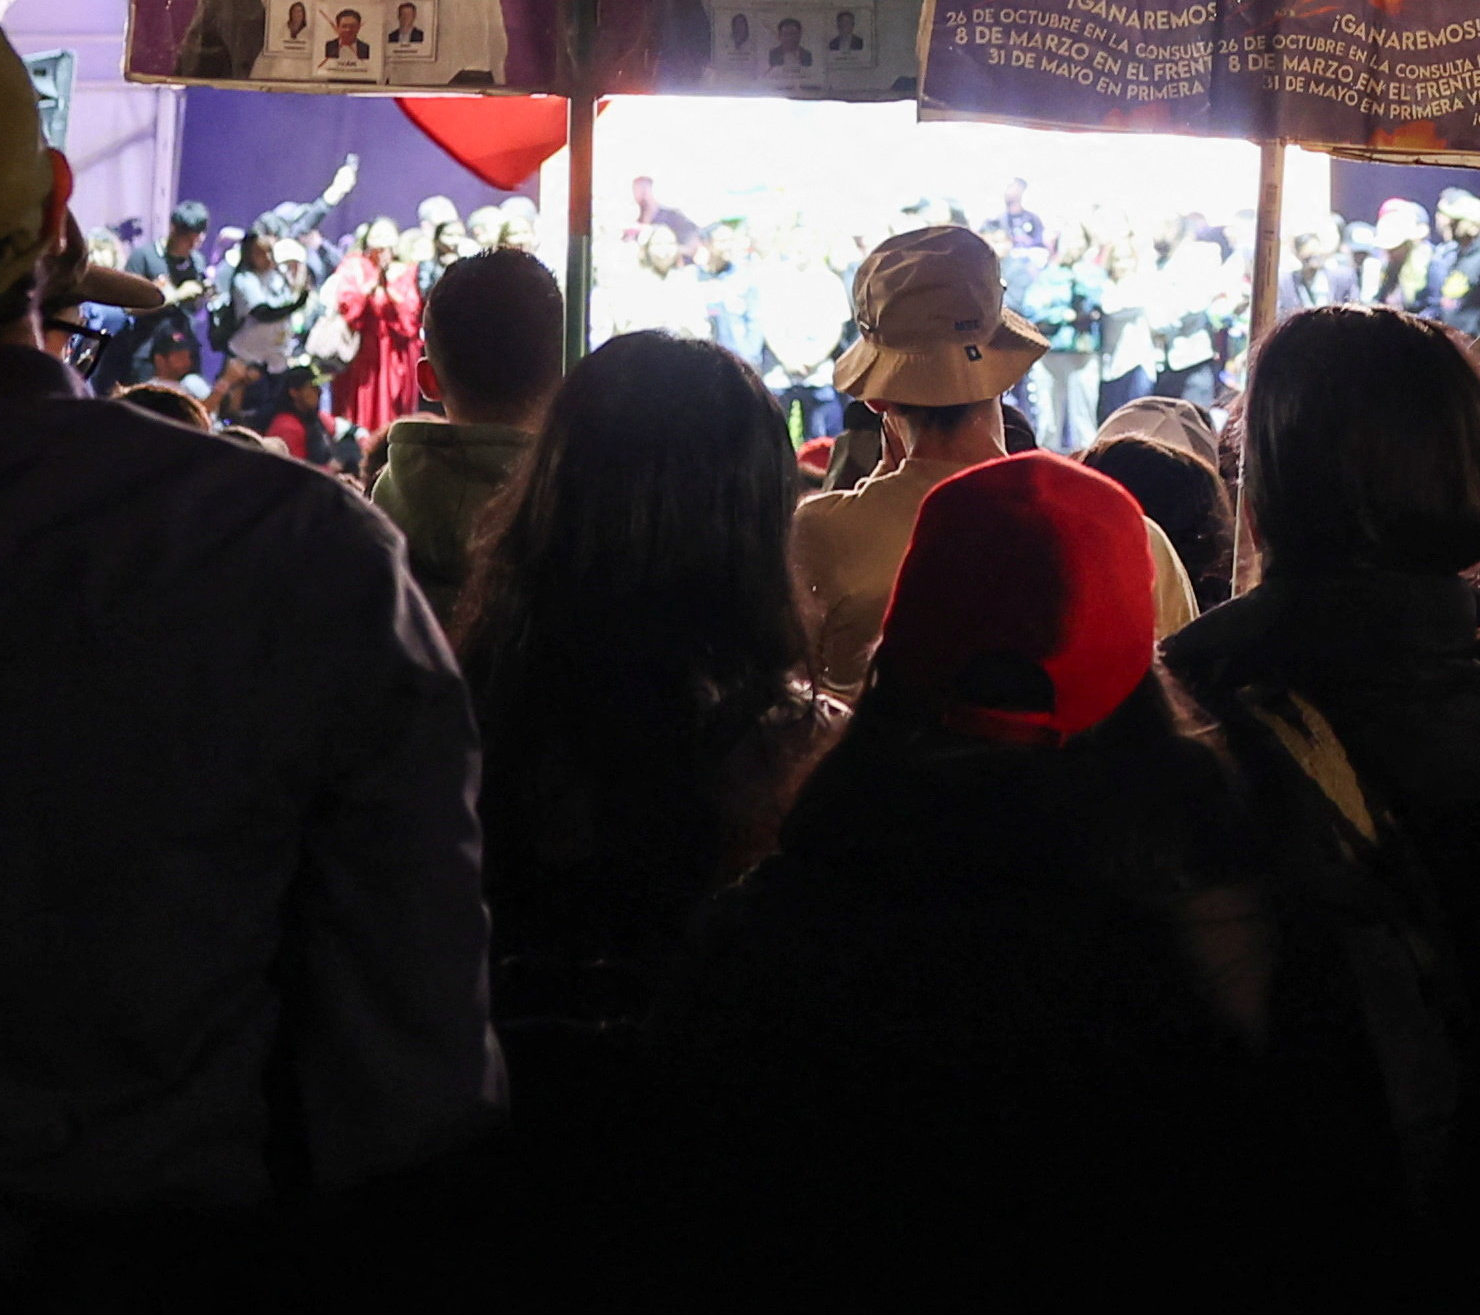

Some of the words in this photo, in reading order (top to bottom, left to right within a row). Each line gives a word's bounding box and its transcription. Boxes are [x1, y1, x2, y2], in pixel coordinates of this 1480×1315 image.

[946, 12, 967, 27] 26
[973, 8, 994, 24] DE
[1000, 9, 1081, 33] OCTUBRE
[1084, 23, 1107, 42] EN
[1109, 33, 1129, 54] LA
[955, 28, 968, 45] 8
[975, 26, 1002, 45] DE
[1009, 31, 1090, 61] MARZO
[1093, 51, 1121, 75] EN
[1126, 61, 1149, 82] EL
[988, 49, 1006, 64] 31
[1011, 50, 1035, 69] DE
[1040, 56, 1093, 85] MAYO
[1096, 77, 1121, 97] EN
[1126, 79, 1205, 101] PRIMERA
[1219, 39, 1238, 54] 26
[1243, 36, 1266, 50] DE
[1272, 34, 1345, 55] OCTUBRE
[1349, 46, 1367, 63] EN
[1370, 54, 1390, 74] LA
[1395, 59, 1473, 79] CONSULTA
[1228, 55, 1240, 73] 8
[1248, 53, 1275, 70] DE
[1283, 55, 1353, 84] MARZO
[1357, 73, 1385, 97] EN
[1389, 82, 1410, 101] EL
[1263, 74, 1279, 90] 31
[1286, 76, 1304, 92] DE
[1309, 80, 1358, 106] MAYO
[1360, 98, 1385, 116] EN
[1389, 99, 1464, 120] PRIMERA
